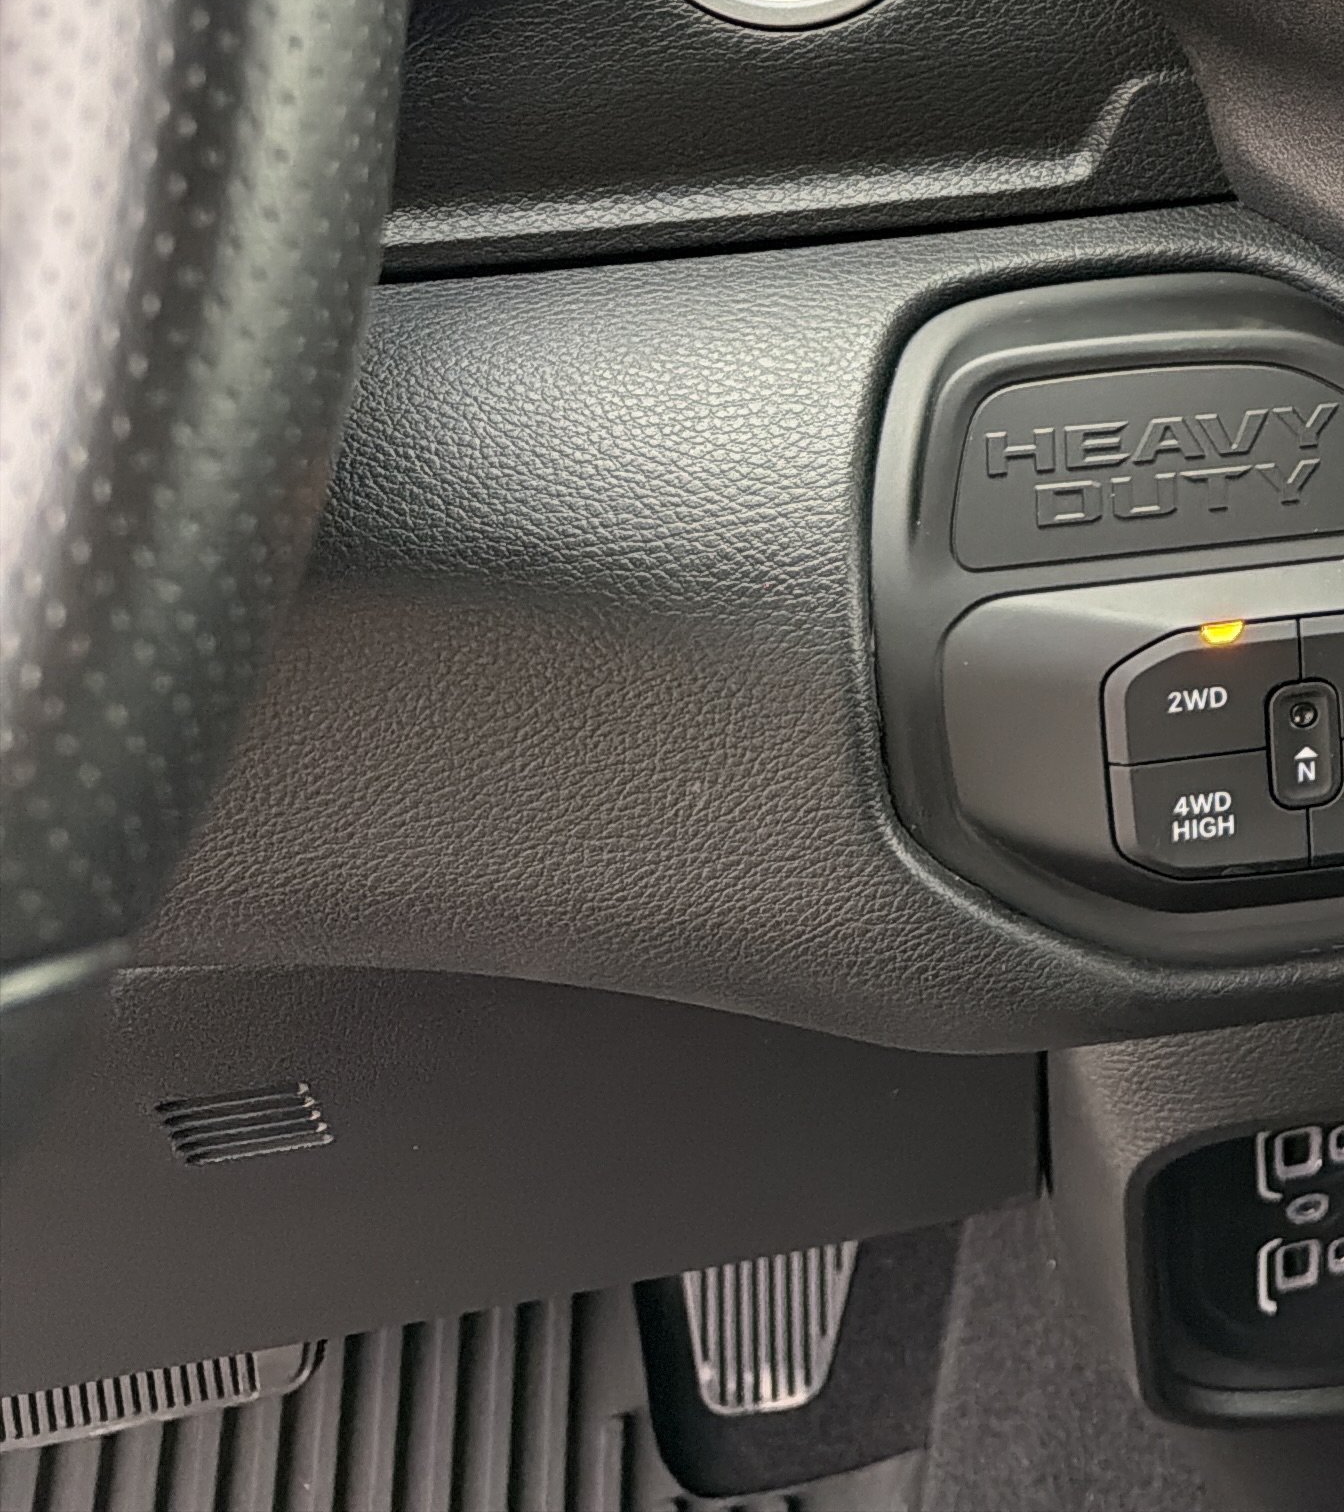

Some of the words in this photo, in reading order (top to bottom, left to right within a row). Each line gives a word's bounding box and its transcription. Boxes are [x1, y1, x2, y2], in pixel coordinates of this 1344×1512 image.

[985, 402, 1338, 478] HEAVY
[1035, 458, 1321, 528] DUTY
[1167, 687, 1228, 714] 2WD
[1298, 760, 1316, 783] N
[1173, 791, 1232, 818] 4WD
[1172, 815, 1236, 843] HIGH
